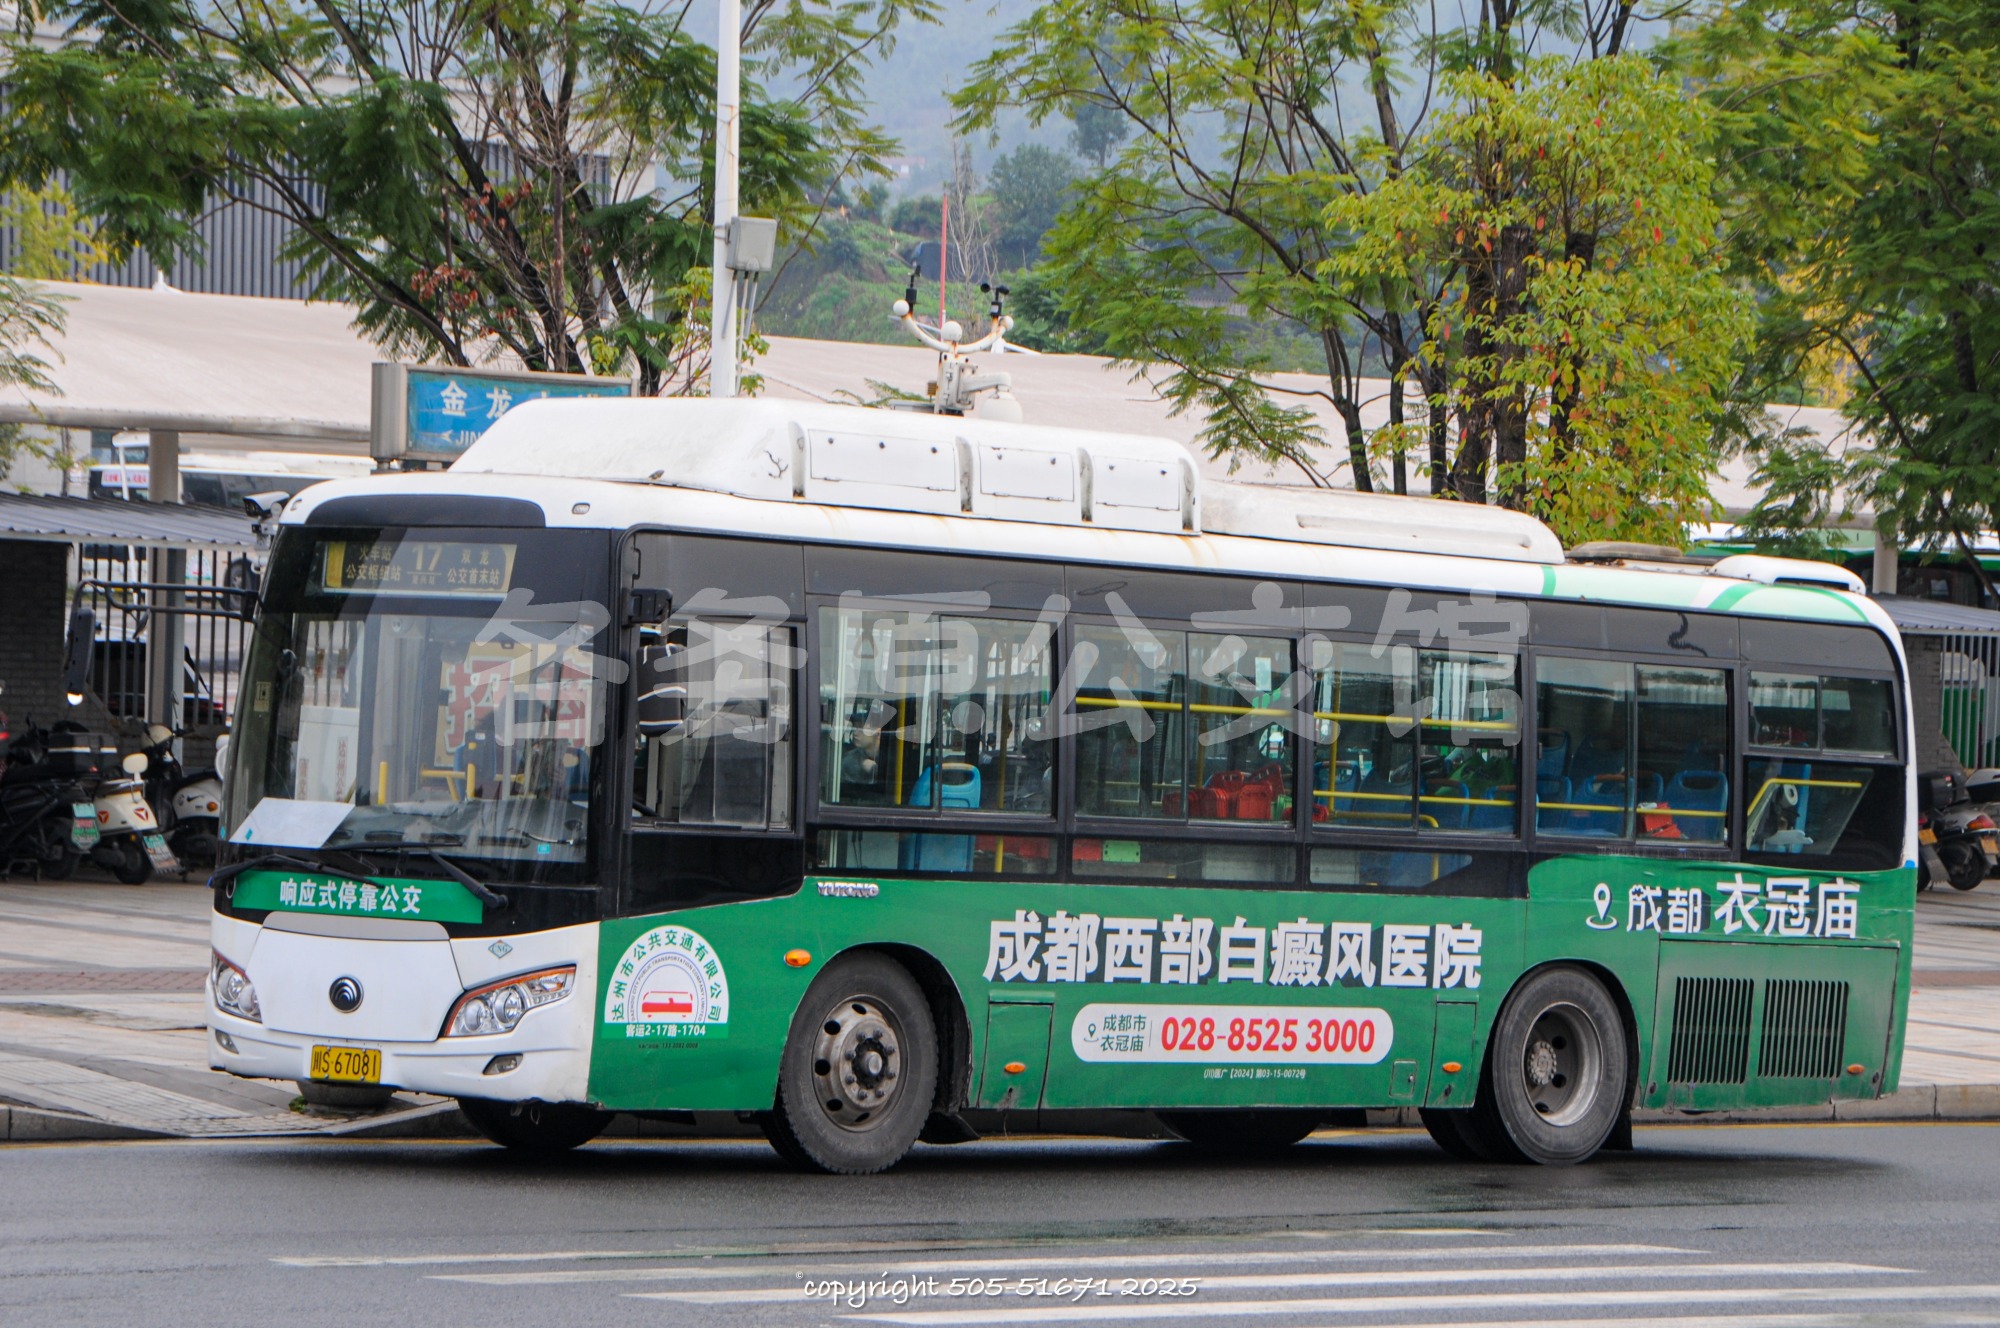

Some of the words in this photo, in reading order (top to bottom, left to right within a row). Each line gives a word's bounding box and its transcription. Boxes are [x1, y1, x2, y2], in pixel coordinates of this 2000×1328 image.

[358, 545, 392, 562] 火车站
[412, 544, 444, 571] 17
[461, 550, 489, 565] 双龙
[346, 564, 401, 582] 公交枢纽站
[447, 568, 500, 585] 公交首末站
[279, 877, 423, 914] 响应式停靠公交
[817, 881, 880, 898] YUTONG
[1714, 873, 1861, 939] 衣冠庙
[982, 909, 1484, 990] 成都西部白癜风医院
[652, 955, 693, 970] TRANSPORTATION
[611, 929, 722, 1022] 达州市公共交通有限公司
[626, 1024, 706, 1037] 客运2-17路-1704
[1103, 1014, 1147, 1032] 成都市
[1100, 1034, 1144, 1052] 衣冠庙
[1161, 1016, 1298, 1051] 028-8525
[1305, 1019, 1375, 1053] 3000
